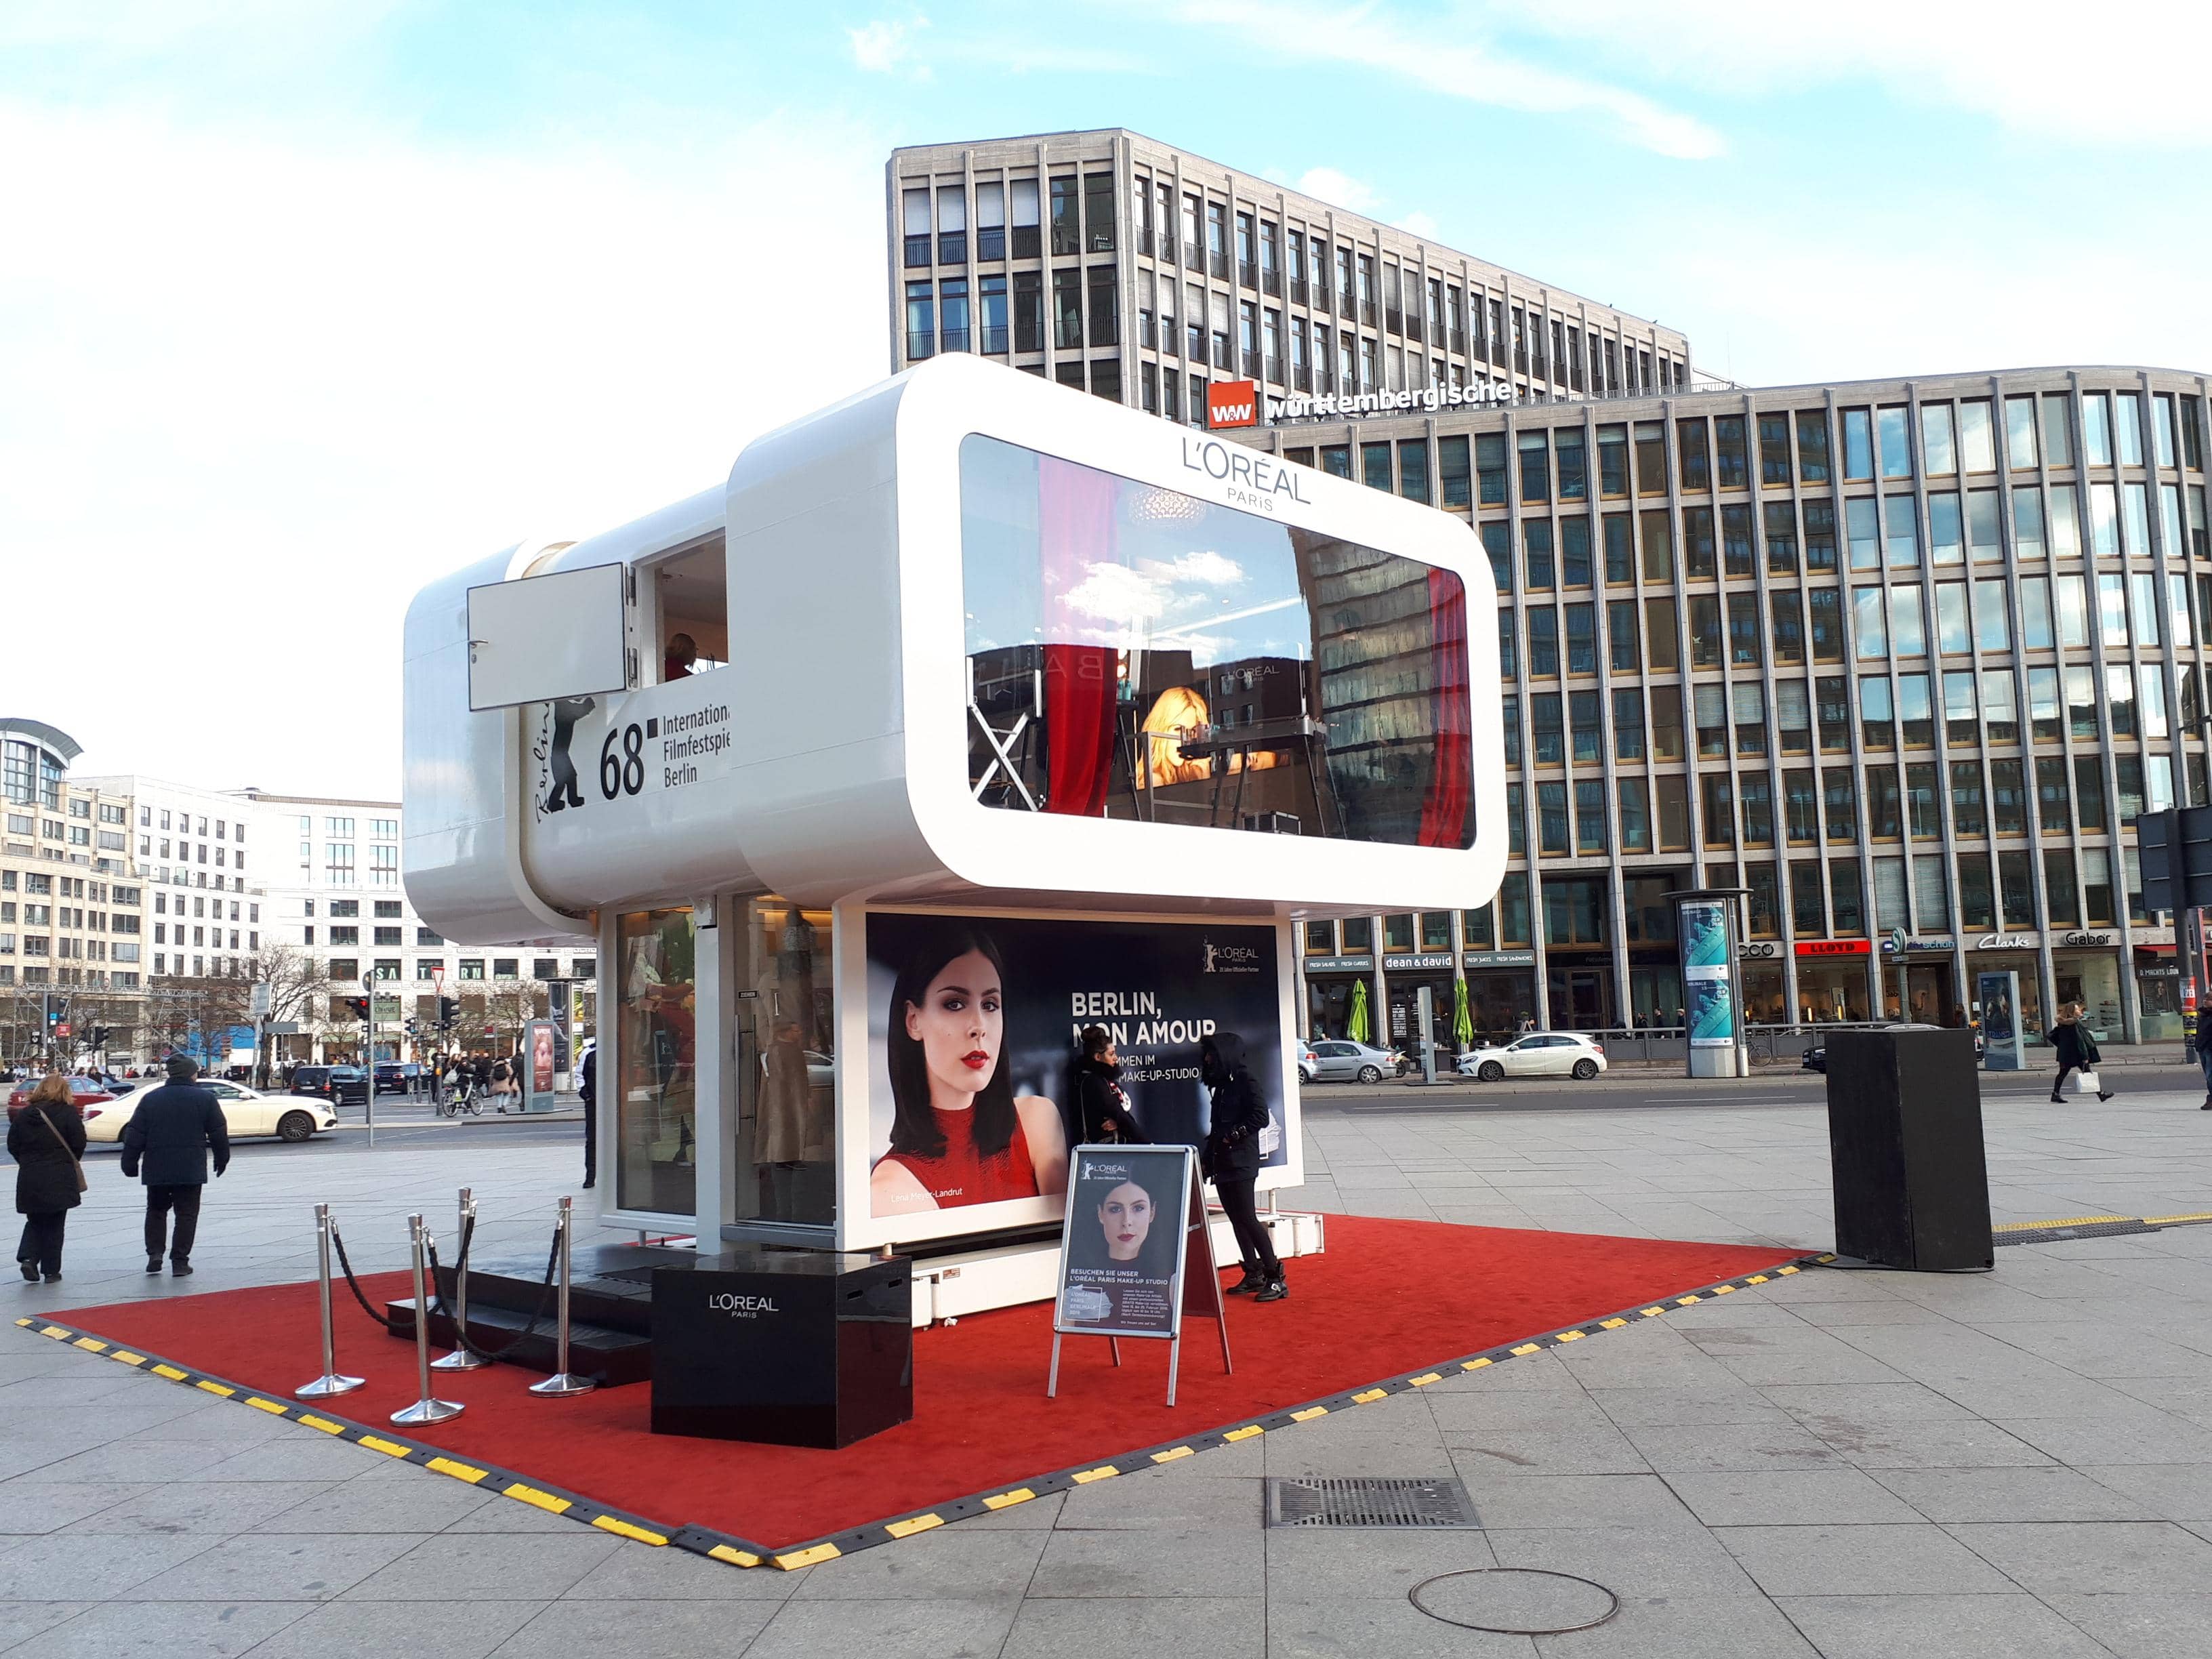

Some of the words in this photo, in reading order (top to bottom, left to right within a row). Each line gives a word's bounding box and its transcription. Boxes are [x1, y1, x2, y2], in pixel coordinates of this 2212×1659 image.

[1265, 379, 1512, 419] württembergische
[1182, 436, 1311, 505] L'ORÉAL
[663, 703, 731, 735] Internation
[600, 723, 644, 800] 68
[665, 764, 697, 788] Berlin
[1978, 935, 2030, 949] Clarks
[2066, 932, 2111, 945] Gabor
[1218, 946, 1259, 958] L'ORÉAL
[1810, 943, 1856, 953] LLOYD
[1386, 956, 1412, 968] dean
[1414, 958, 1421, 967] &
[1422, 956, 1452, 967] david
[1071, 991, 1162, 1019] BERLIN,
[1145, 1054, 1155, 1066] IM
[1119, 1067, 1200, 1083] MAKE-UP-STUDIO
[891, 1193, 909, 1203] Lena
[911, 1187, 963, 1200] Meyer-Landrut
